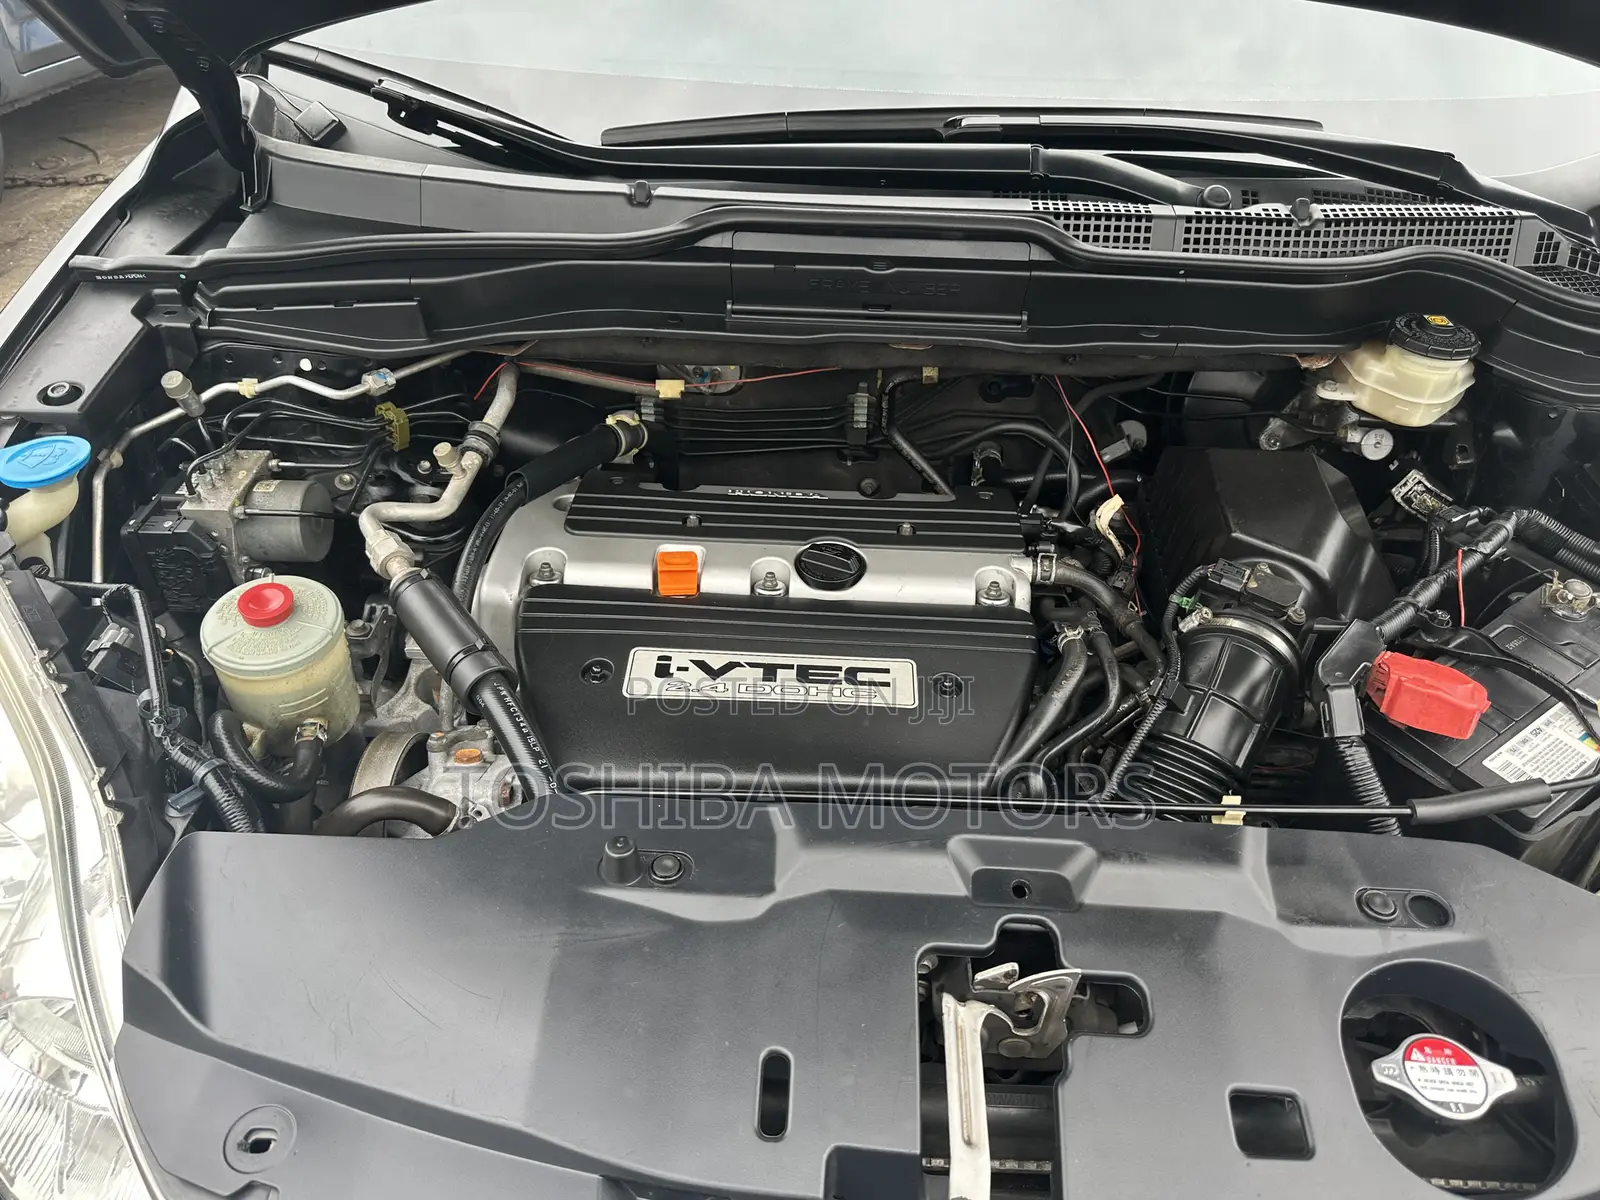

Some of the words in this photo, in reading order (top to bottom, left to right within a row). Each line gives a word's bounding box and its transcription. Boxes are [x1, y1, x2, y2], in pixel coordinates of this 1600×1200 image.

[654, 654, 891, 688] i-VTEC
[665, 680, 730, 694] 2.4
[737, 682, 878, 700] DOHC
